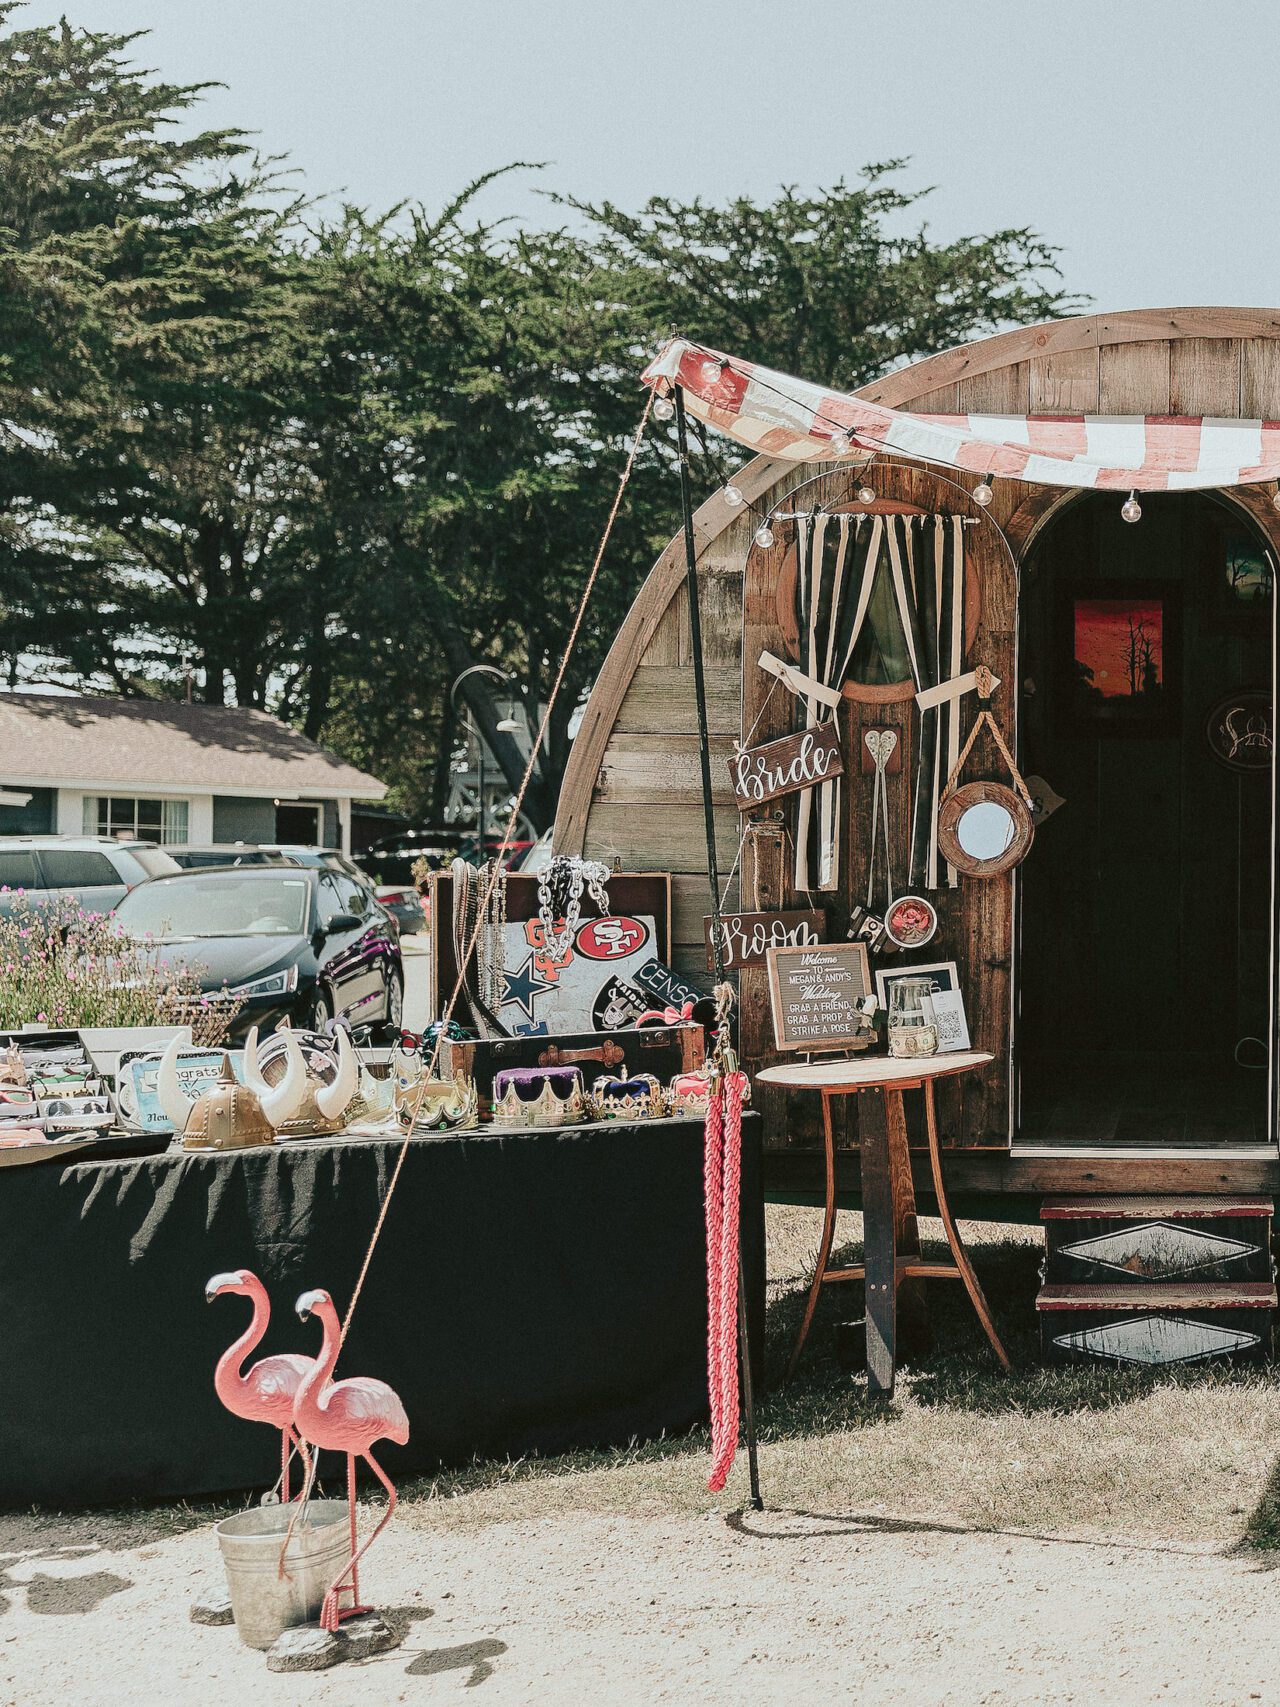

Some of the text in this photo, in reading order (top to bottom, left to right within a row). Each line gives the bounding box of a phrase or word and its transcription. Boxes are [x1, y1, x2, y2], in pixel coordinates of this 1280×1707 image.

[736, 734, 838, 800] bride
[594, 919, 638, 955] SF
[709, 917, 819, 967] groom
[801, 952, 838, 966] Welcome
[812, 966, 823, 975] TO
[825, 972, 852, 984] ANDY'S
[614, 979, 650, 1012] RAIDER
[799, 984, 842, 1003] Wedding
[789, 1003, 811, 1013] GRAB
[813, 1003, 820, 1012] A
[787, 1014, 809, 1025] GRAB
[813, 1014, 819, 1023] A
[821, 1012, 843, 1022] PROP
[791, 1023, 851, 1036] STRIKE A POSE
